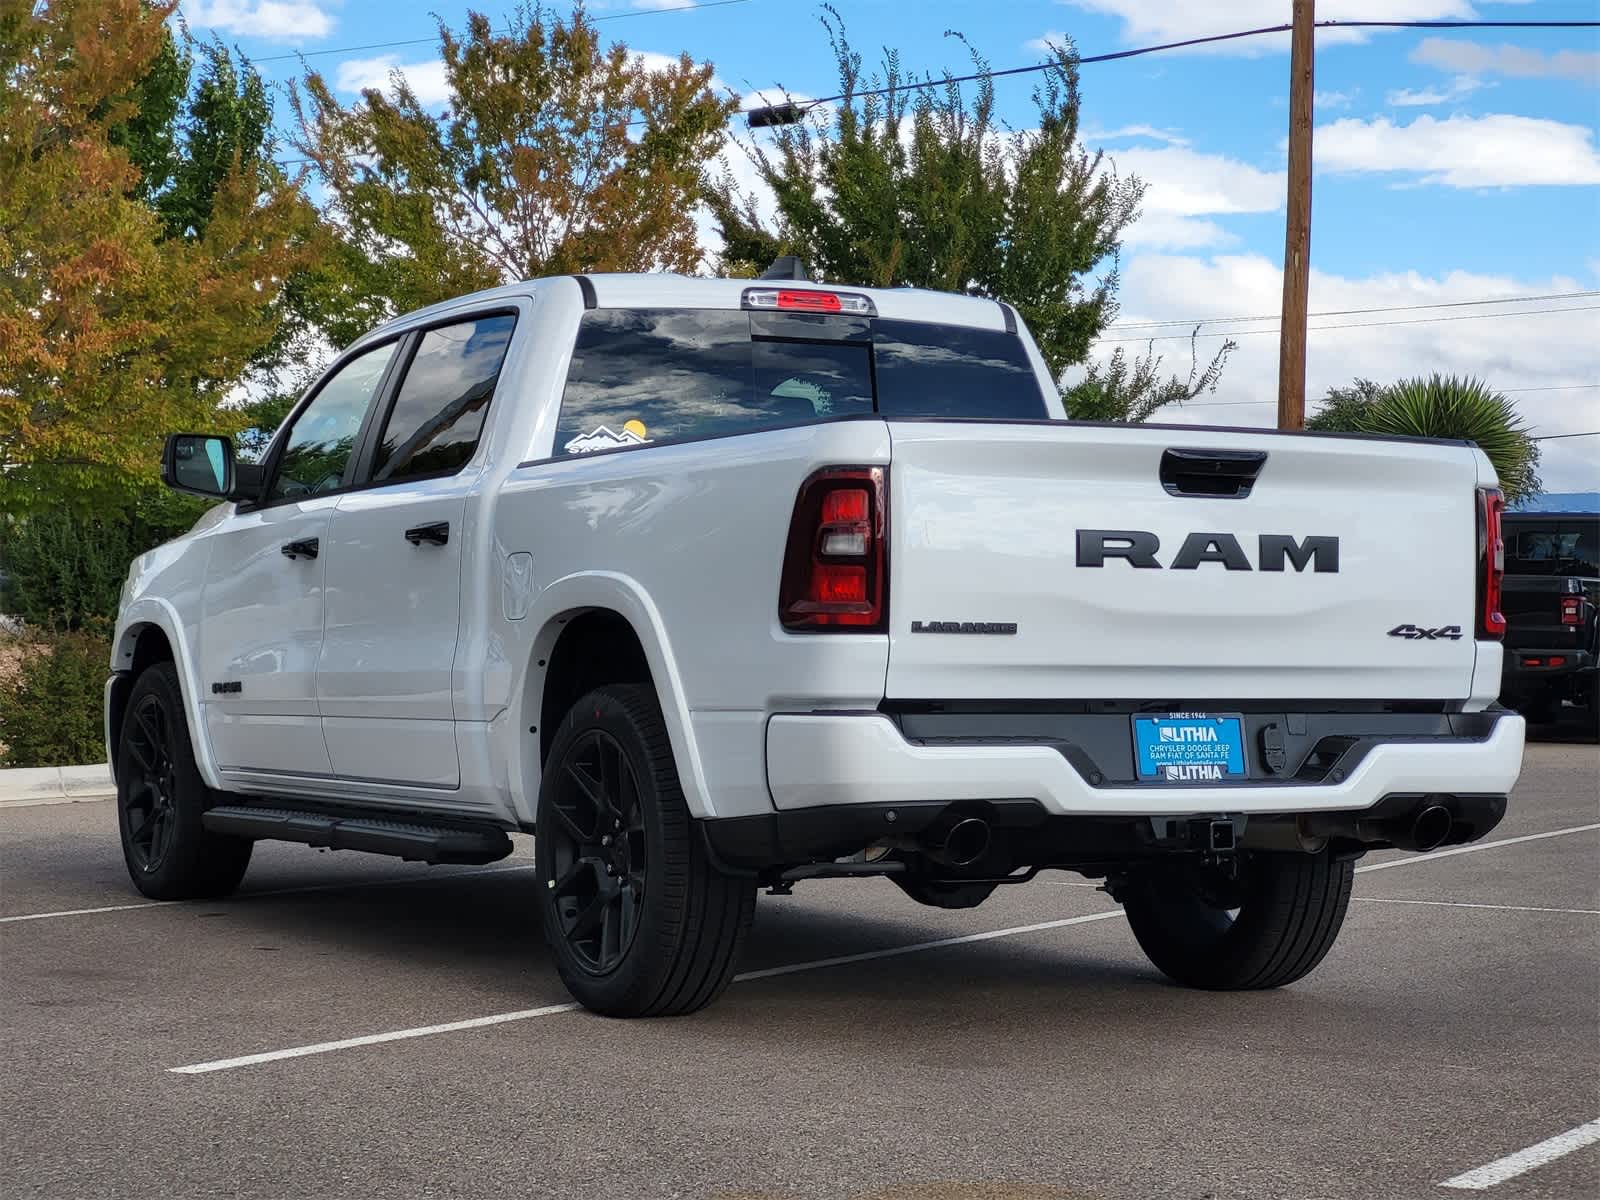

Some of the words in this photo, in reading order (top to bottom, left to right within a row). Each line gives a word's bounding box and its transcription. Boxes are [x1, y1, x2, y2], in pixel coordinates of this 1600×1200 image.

[1075, 528, 1339, 573] RAM
[1386, 623, 1463, 641] 4x4
[1173, 727, 1218, 742] LITHIA
[1149, 744, 1186, 752] CHRYSLER
[1187, 744, 1212, 752] DODGE
[1214, 744, 1230, 752] JEEP
[1179, 765, 1222, 780] LITHIA
